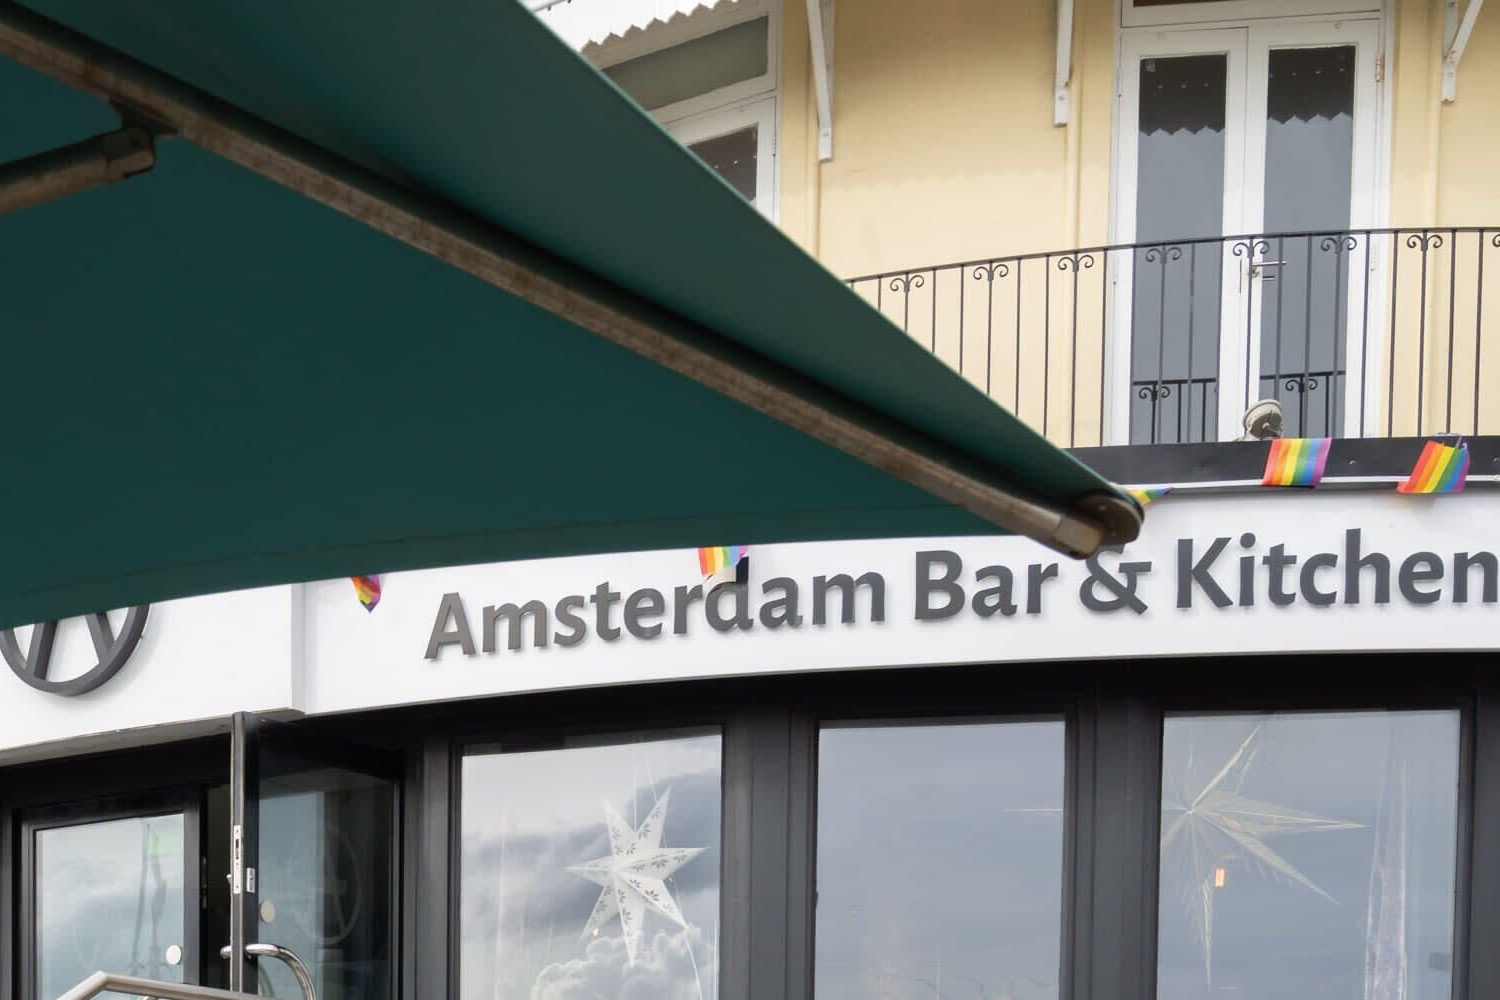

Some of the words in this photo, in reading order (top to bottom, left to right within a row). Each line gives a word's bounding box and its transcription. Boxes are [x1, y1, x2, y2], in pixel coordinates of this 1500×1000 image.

[424, 556, 886, 659] Amsterdam
[915, 550, 1058, 620] Bar
[1079, 543, 1152, 615] &
[1176, 528, 1498, 609] Kitchen
